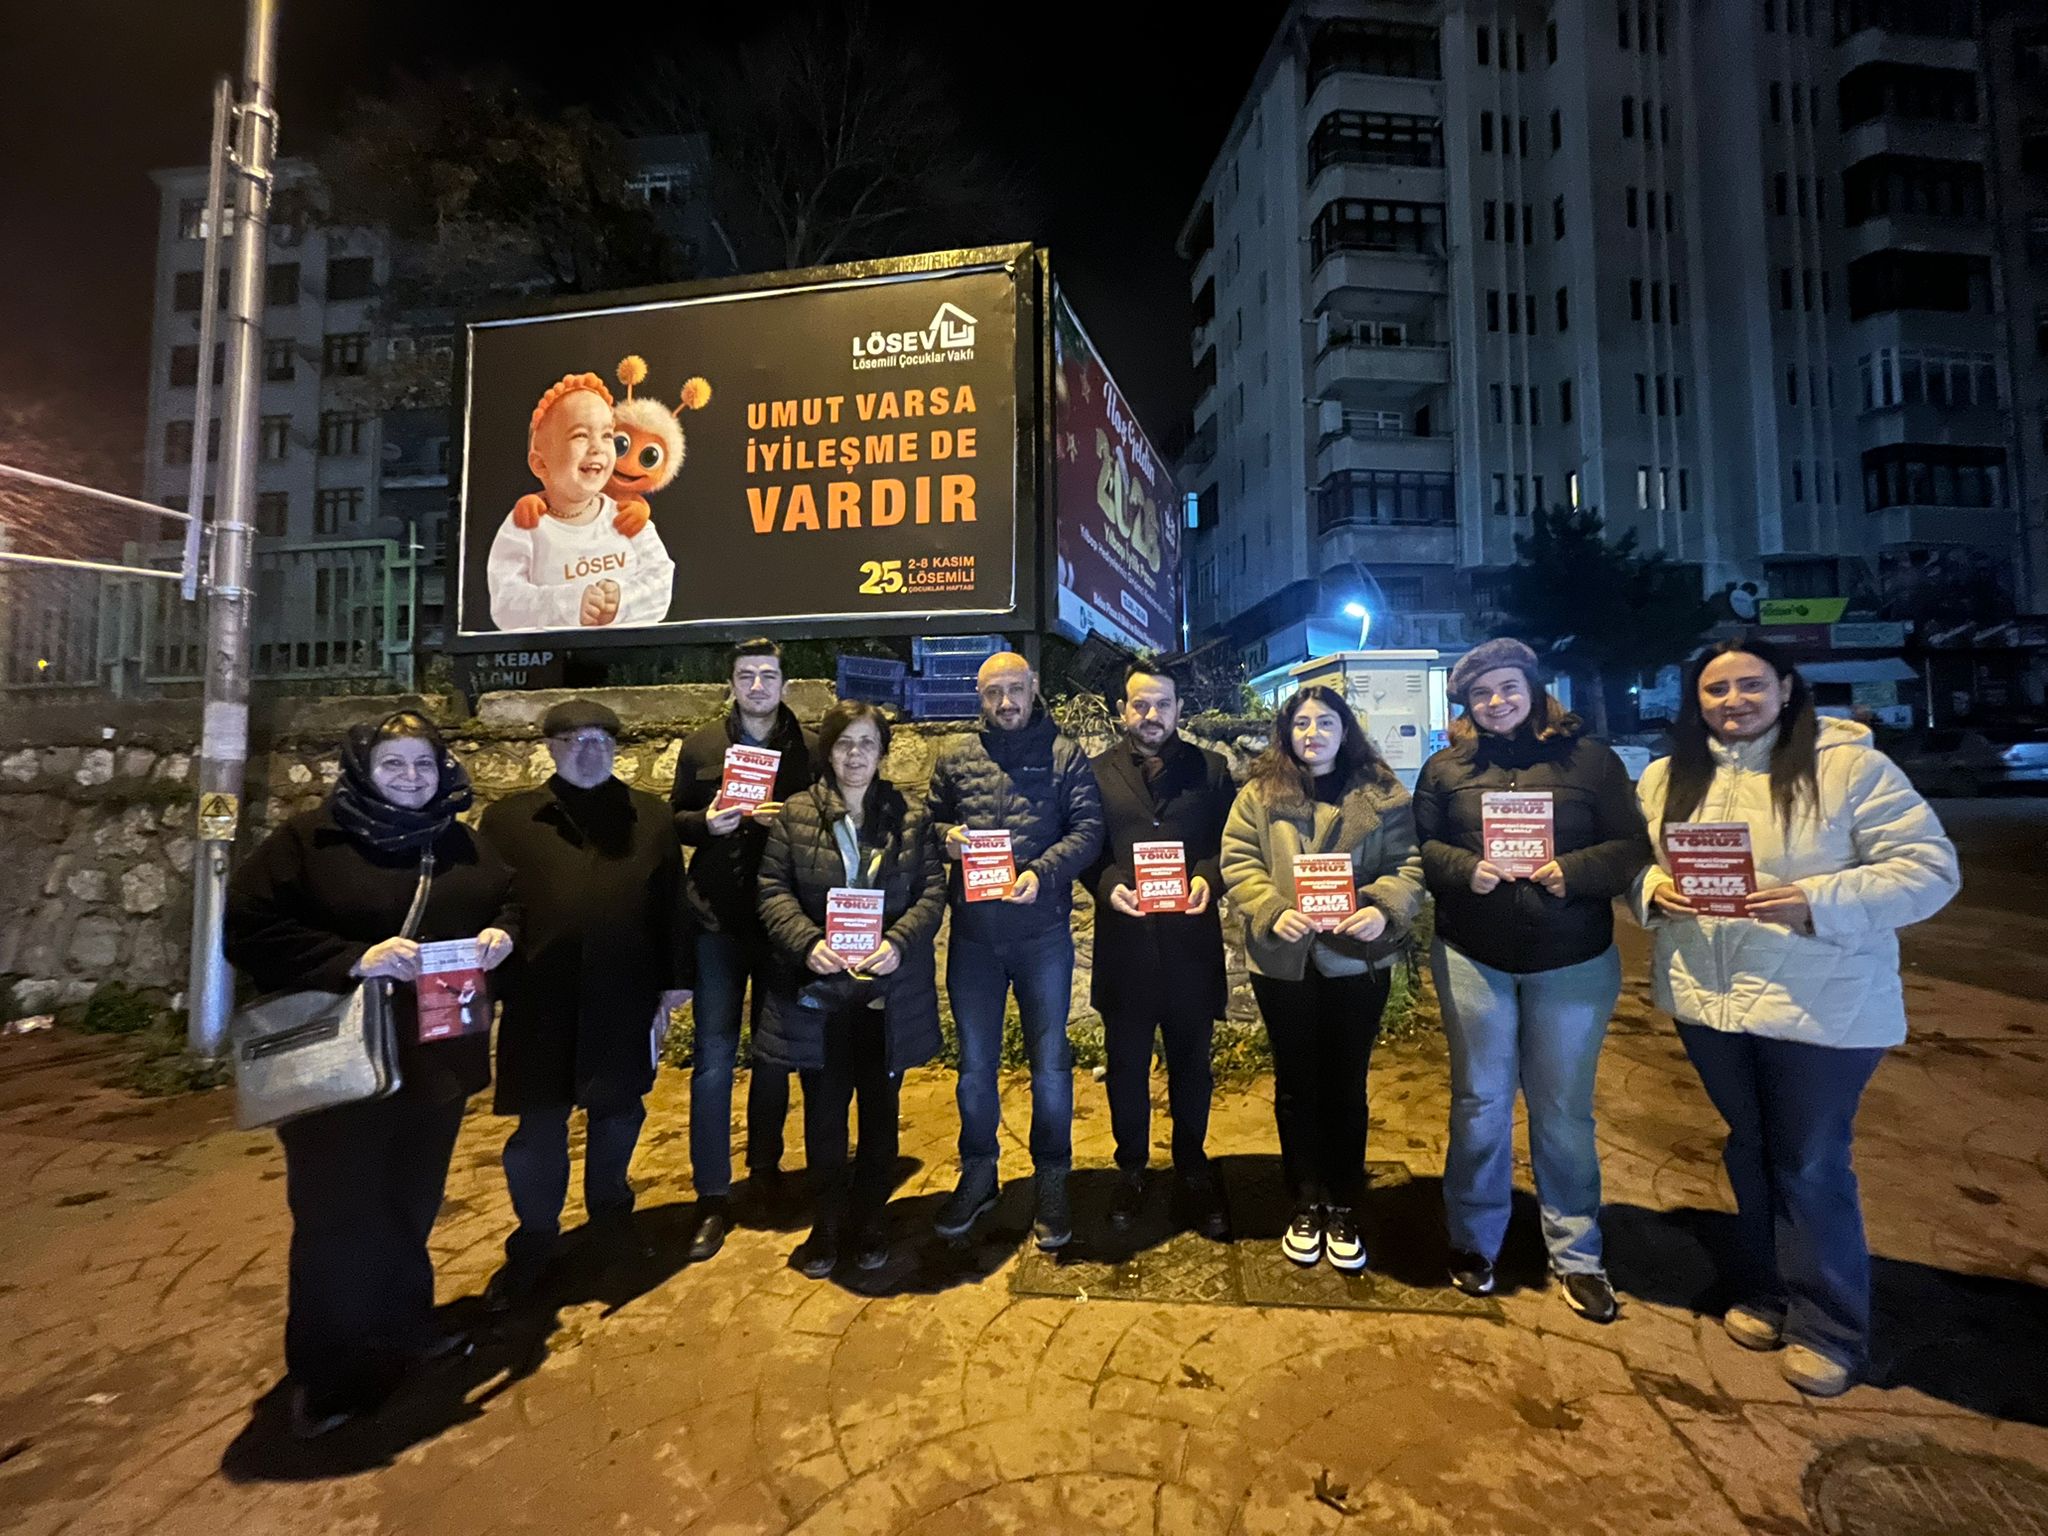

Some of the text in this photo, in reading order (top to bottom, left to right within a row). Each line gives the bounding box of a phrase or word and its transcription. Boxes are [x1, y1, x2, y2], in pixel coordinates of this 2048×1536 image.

[852, 330, 938, 357] LÖSEV
[852, 348, 975, 371] Lösemili Çocuklar Vakfı
[747, 385, 977, 430] UMUT VARSA
[746, 428, 977, 475] İYİLEŞME DE
[746, 473, 977, 534] VARDIR
[563, 551, 627, 580] LÖSEV
[859, 559, 908, 594] 25.
[908, 556, 975, 569] 2-8 KASIM
[908, 568, 975, 585] LÖSEMİLİ
[494, 651, 554, 667] KEBAP
